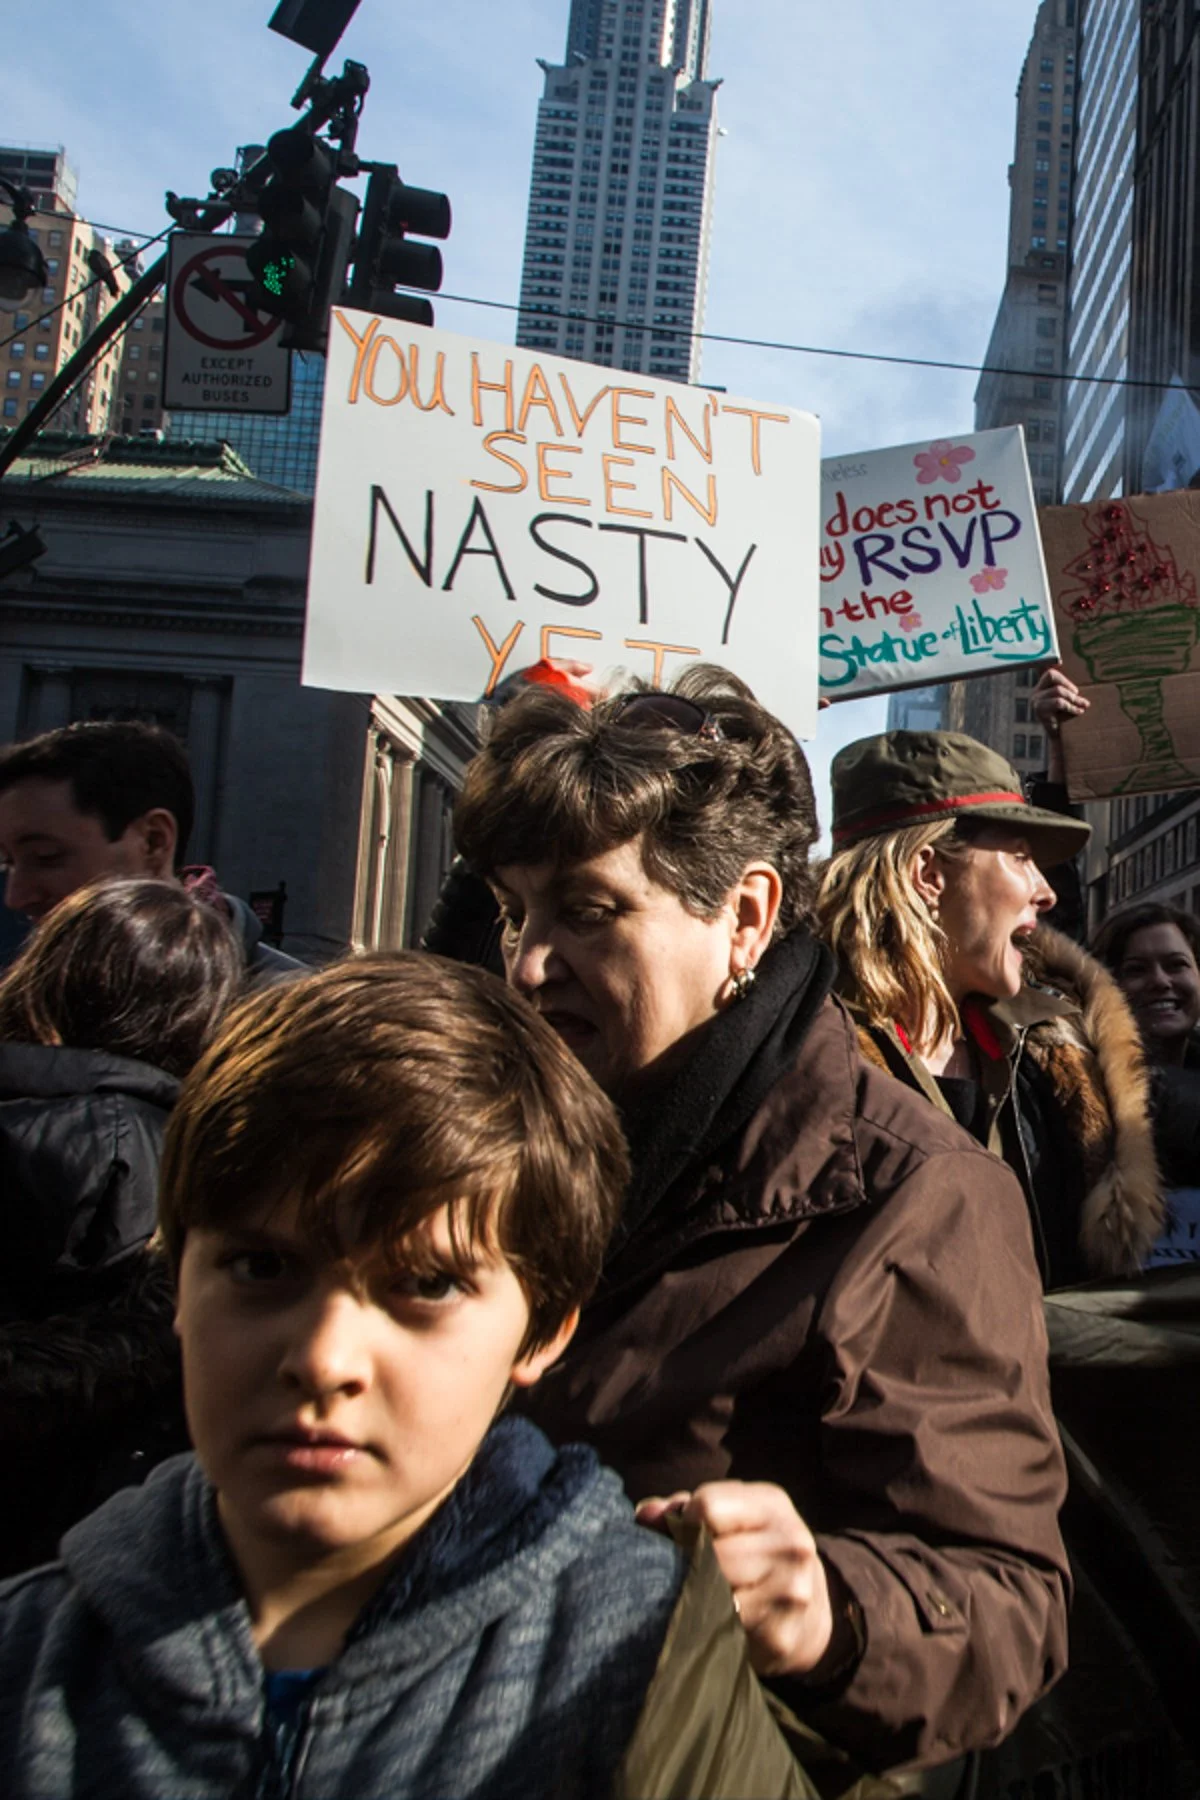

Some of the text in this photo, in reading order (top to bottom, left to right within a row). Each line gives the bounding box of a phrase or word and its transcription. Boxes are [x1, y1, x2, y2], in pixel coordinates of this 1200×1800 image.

[182, 373, 273, 387] AUTHORIZED
[200, 356, 254, 370] EXCEPT
[202, 389, 249, 402] BUSES
[334, 309, 790, 476] YOU HAVEN'T
[467, 430, 717, 527] SEEN
[825, 479, 1001, 537] does not
[365, 484, 757, 645] NASTY
[819, 510, 1022, 586] y RSVP
[835, 589, 914, 622] the
[819, 630, 940, 687] Statue
